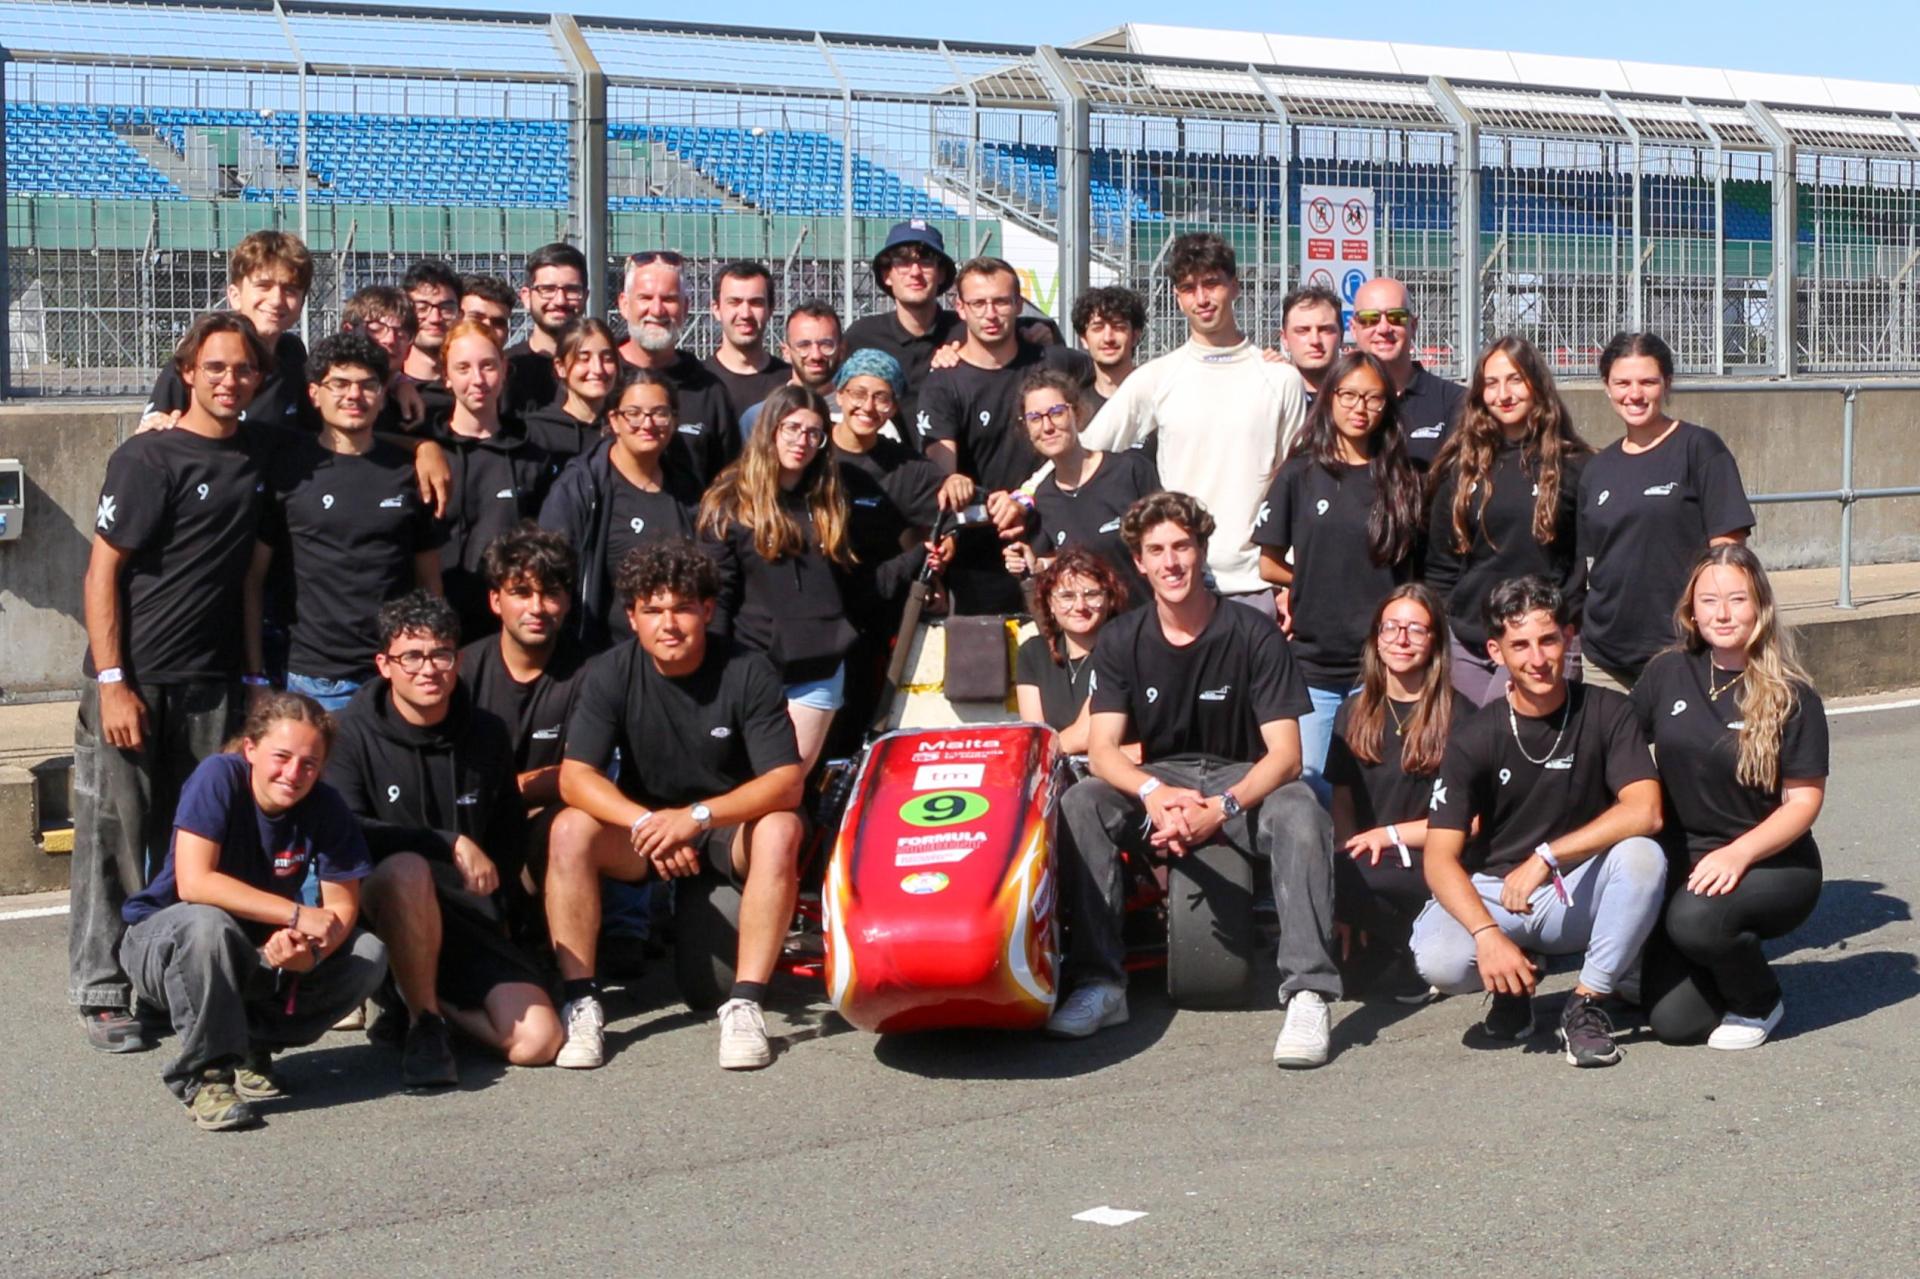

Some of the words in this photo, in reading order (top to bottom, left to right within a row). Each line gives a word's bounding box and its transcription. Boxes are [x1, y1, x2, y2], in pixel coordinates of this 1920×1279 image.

[979, 410, 991, 427] 9
[196, 483, 210, 501] 9
[1597, 489, 1610, 506] 9
[321, 493, 335, 510] 9
[1316, 498, 1330, 516] 9
[630, 517, 645, 534] 9
[1056, 530, 1067, 546] 9
[1145, 686, 1159, 704] 9
[1670, 699, 1688, 716] 9
[918, 739, 1000, 752] Malta
[1498, 767, 1512, 786] 9
[387, 784, 401, 803] 9
[922, 795, 967, 821] 9
[897, 831, 988, 847] FORMULA
